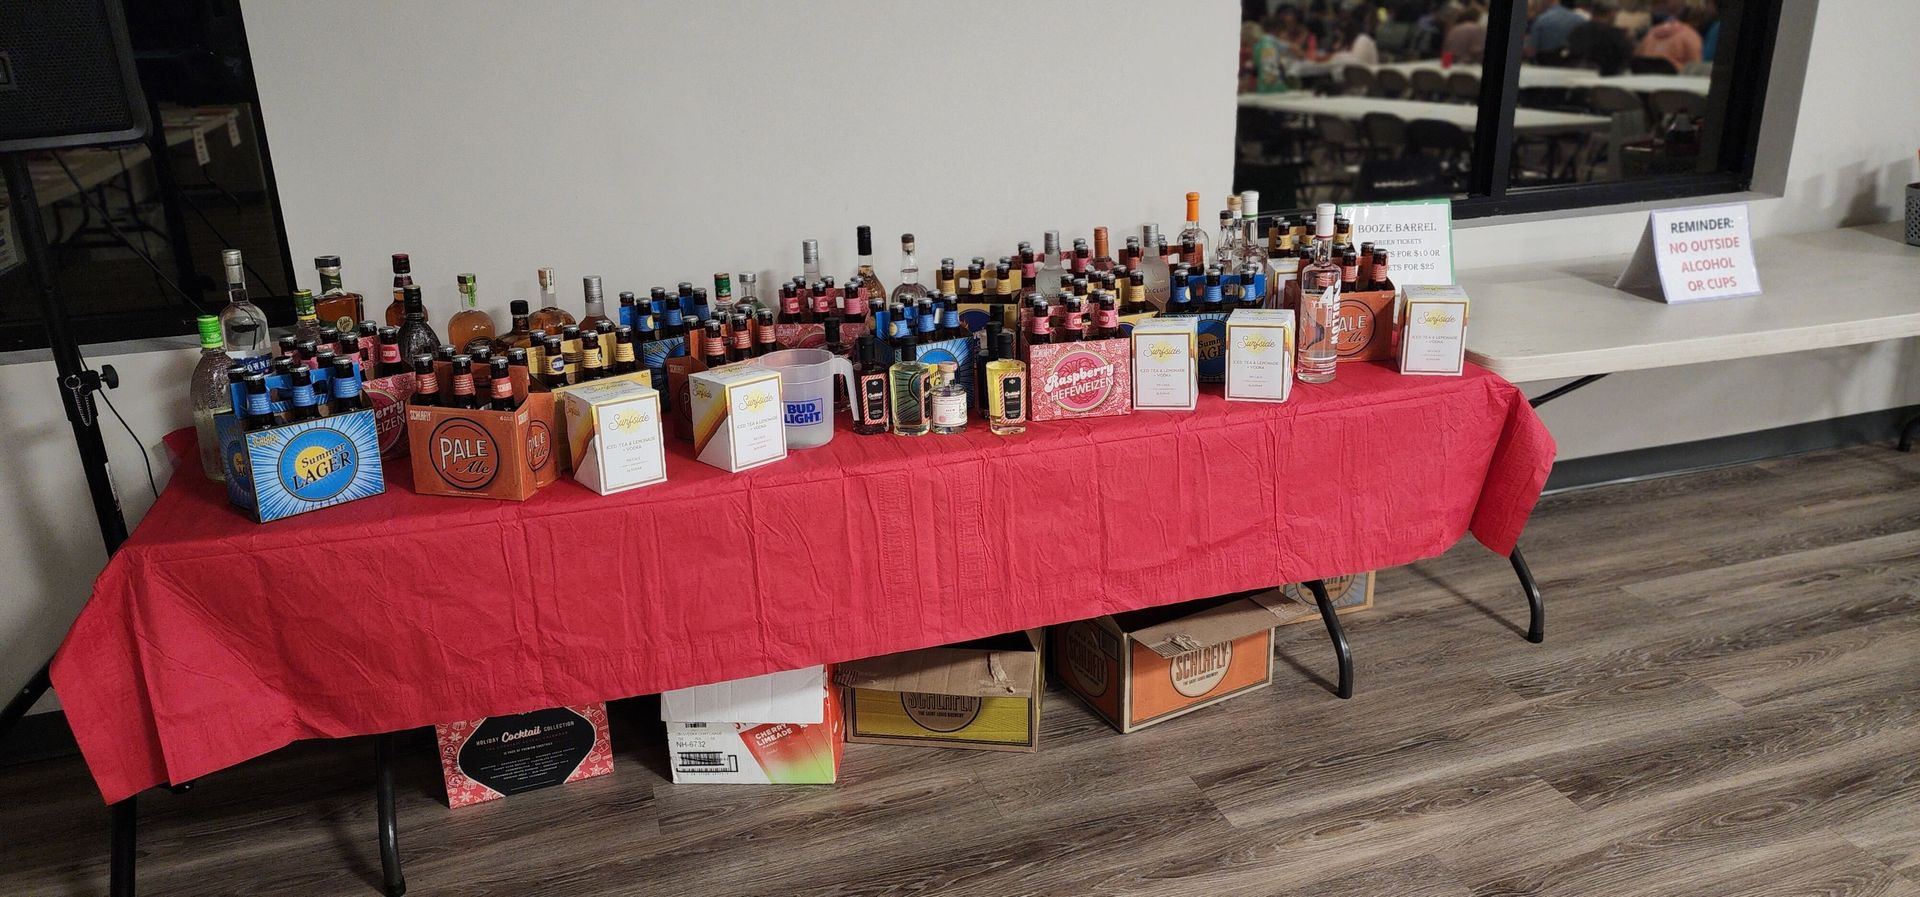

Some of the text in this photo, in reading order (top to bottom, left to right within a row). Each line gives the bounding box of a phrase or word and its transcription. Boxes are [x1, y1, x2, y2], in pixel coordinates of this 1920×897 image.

[1358, 222, 1437, 233] BOOZE BARREL
[1670, 217, 1734, 234] REMINDER:
[1414, 249, 1428, 257] $10
[1669, 237, 1740, 254] NO OUTSIDE
[1403, 263, 1418, 271] FOR
[1420, 262, 1435, 270] $25
[1682, 257, 1735, 273] ALCOHOL
[1688, 276, 1737, 292] OR CUPS
[1339, 315, 1367, 332] ALE
[1417, 311, 1456, 325] Surfside
[1143, 343, 1181, 358] Surfside
[1237, 335, 1276, 350] Surfside
[1044, 363, 1114, 393] Raspberry
[1051, 375, 1114, 402] HEFEWEIZEN
[787, 403, 816, 414] BUD
[608, 411, 651, 431] Surfside
[784, 412, 822, 424] LIGHT
[301, 442, 346, 469] Summer
[439, 437, 488, 471] PALE
[290, 451, 352, 491] LAGER
[455, 460, 492, 475] Ale
[1174, 640, 1229, 682] SCHLAFLY
[475, 720, 575, 746] HOLIDAY Cocktail COLLECTION
[755, 723, 787, 740] CHERRY
[756, 727, 793, 746] LIMEADE
